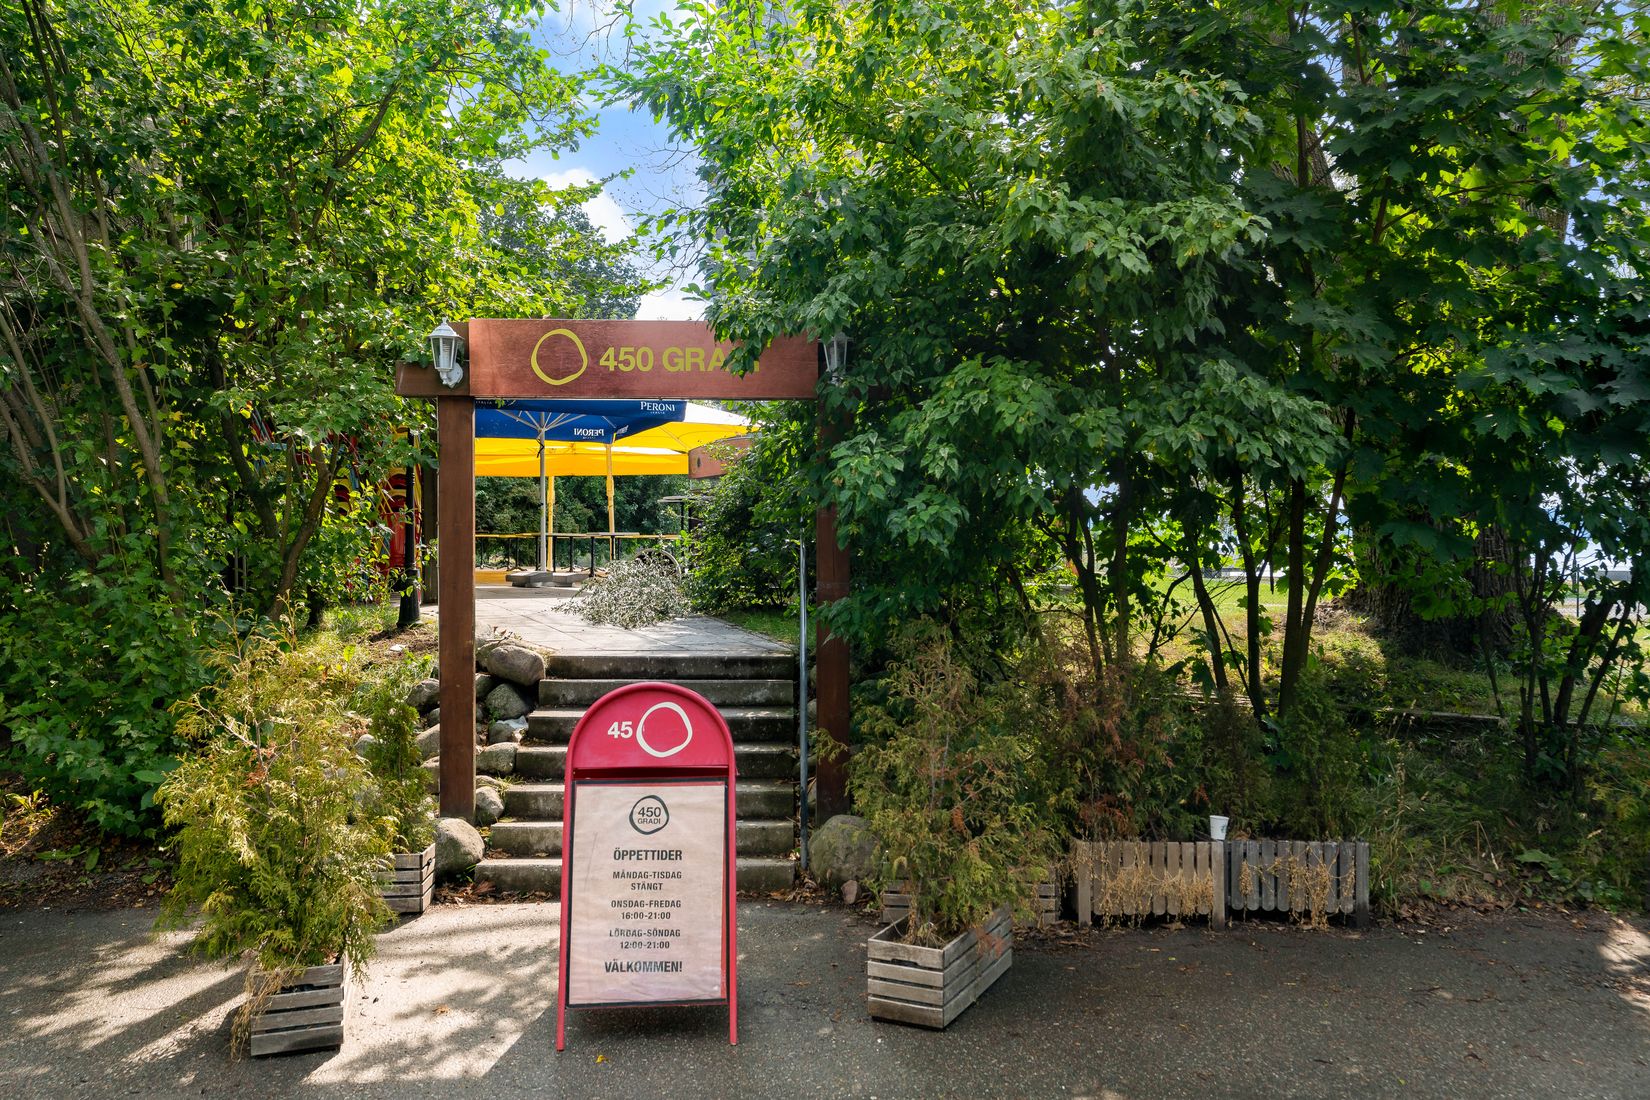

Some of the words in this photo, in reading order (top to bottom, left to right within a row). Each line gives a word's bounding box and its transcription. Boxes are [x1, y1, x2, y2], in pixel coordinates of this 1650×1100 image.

[599, 347, 654, 372] 450
[640, 401, 675, 412] PERONI
[637, 806, 662, 818] 450
[613, 847, 683, 861] ÖPPETTIDER
[612, 869, 682, 879] MÅNDAG-TISDAG
[630, 881, 663, 891] STÄNGT
[611, 900, 682, 908] ONSDAG-FREDAG
[621, 912, 671, 920] 16:00-21:00
[609, 928, 681, 938] LÖRDAG-SÖNDAG
[619, 941, 670, 949] 12:00-21:00
[604, 958, 683, 974] VÄLKOMMEN!
